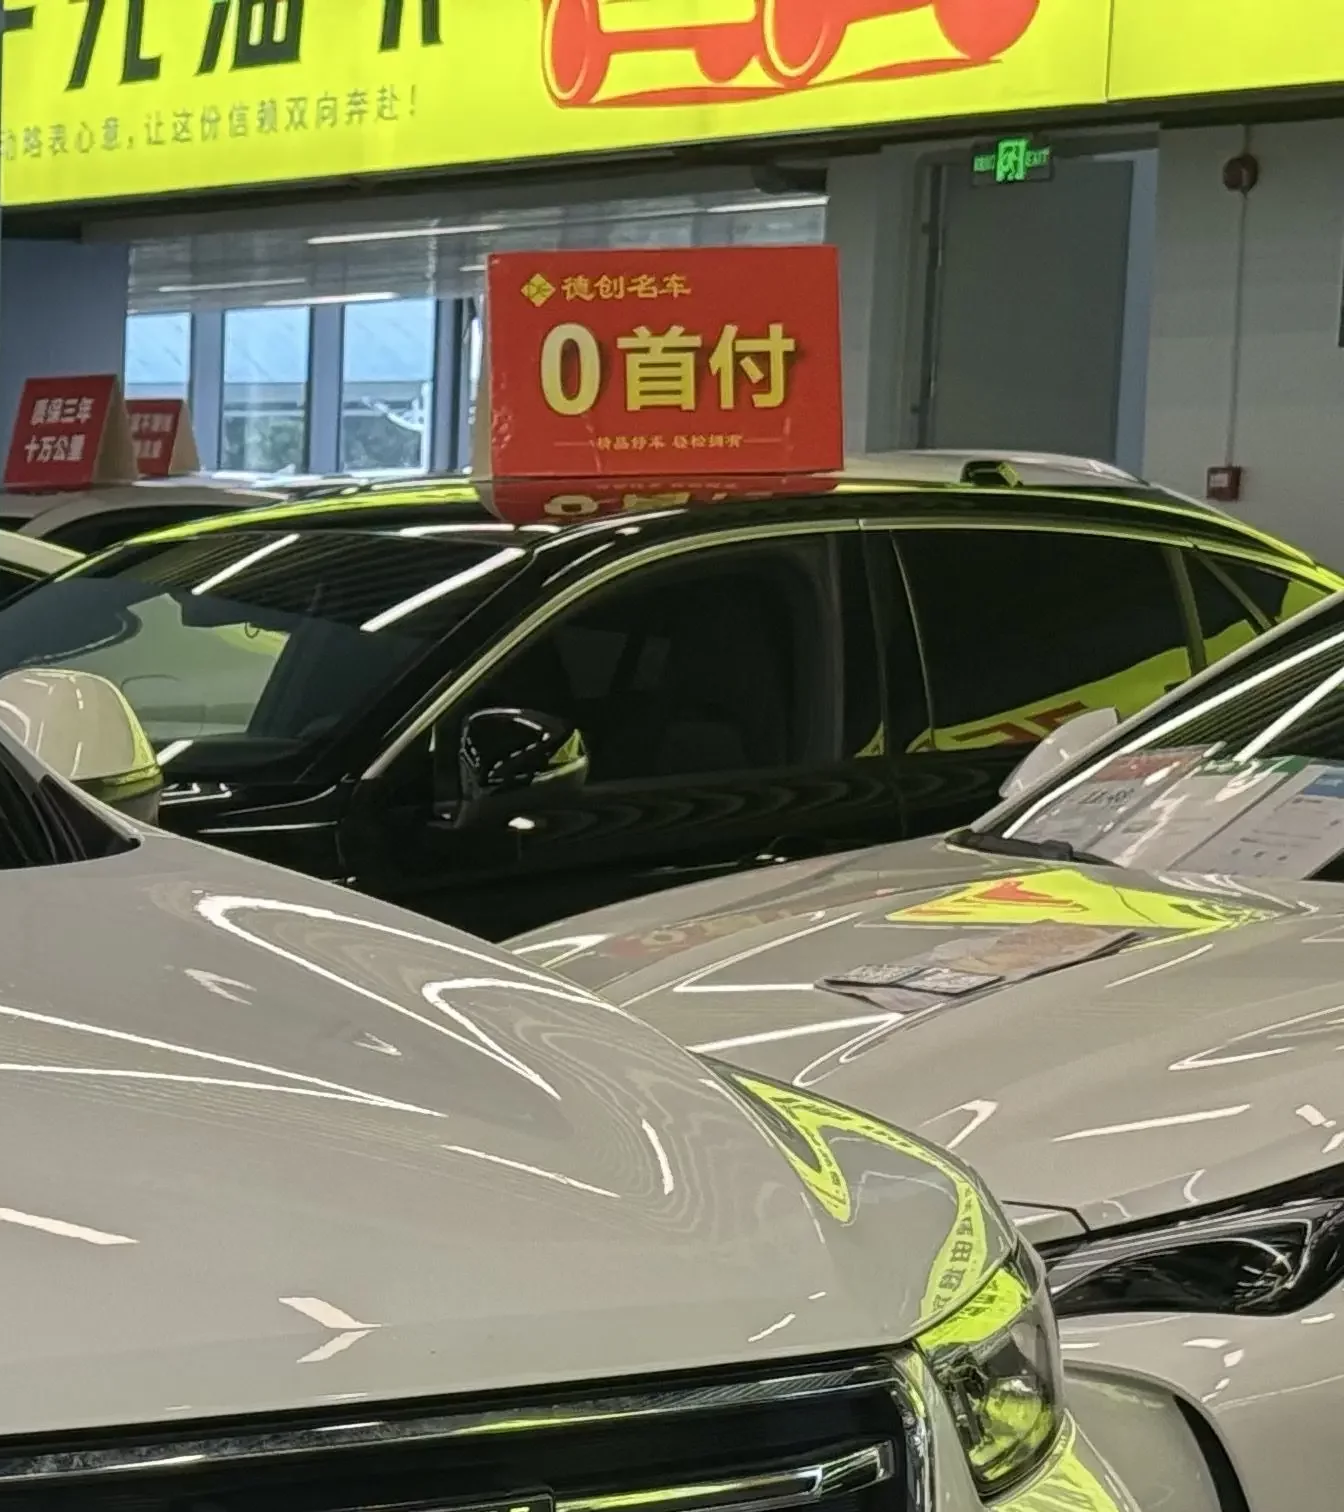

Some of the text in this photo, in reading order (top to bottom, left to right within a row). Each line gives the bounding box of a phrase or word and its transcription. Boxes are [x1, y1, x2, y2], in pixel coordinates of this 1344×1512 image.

[561, 273, 692, 301] 德创名车
[540, 321, 796, 416] 0首付
